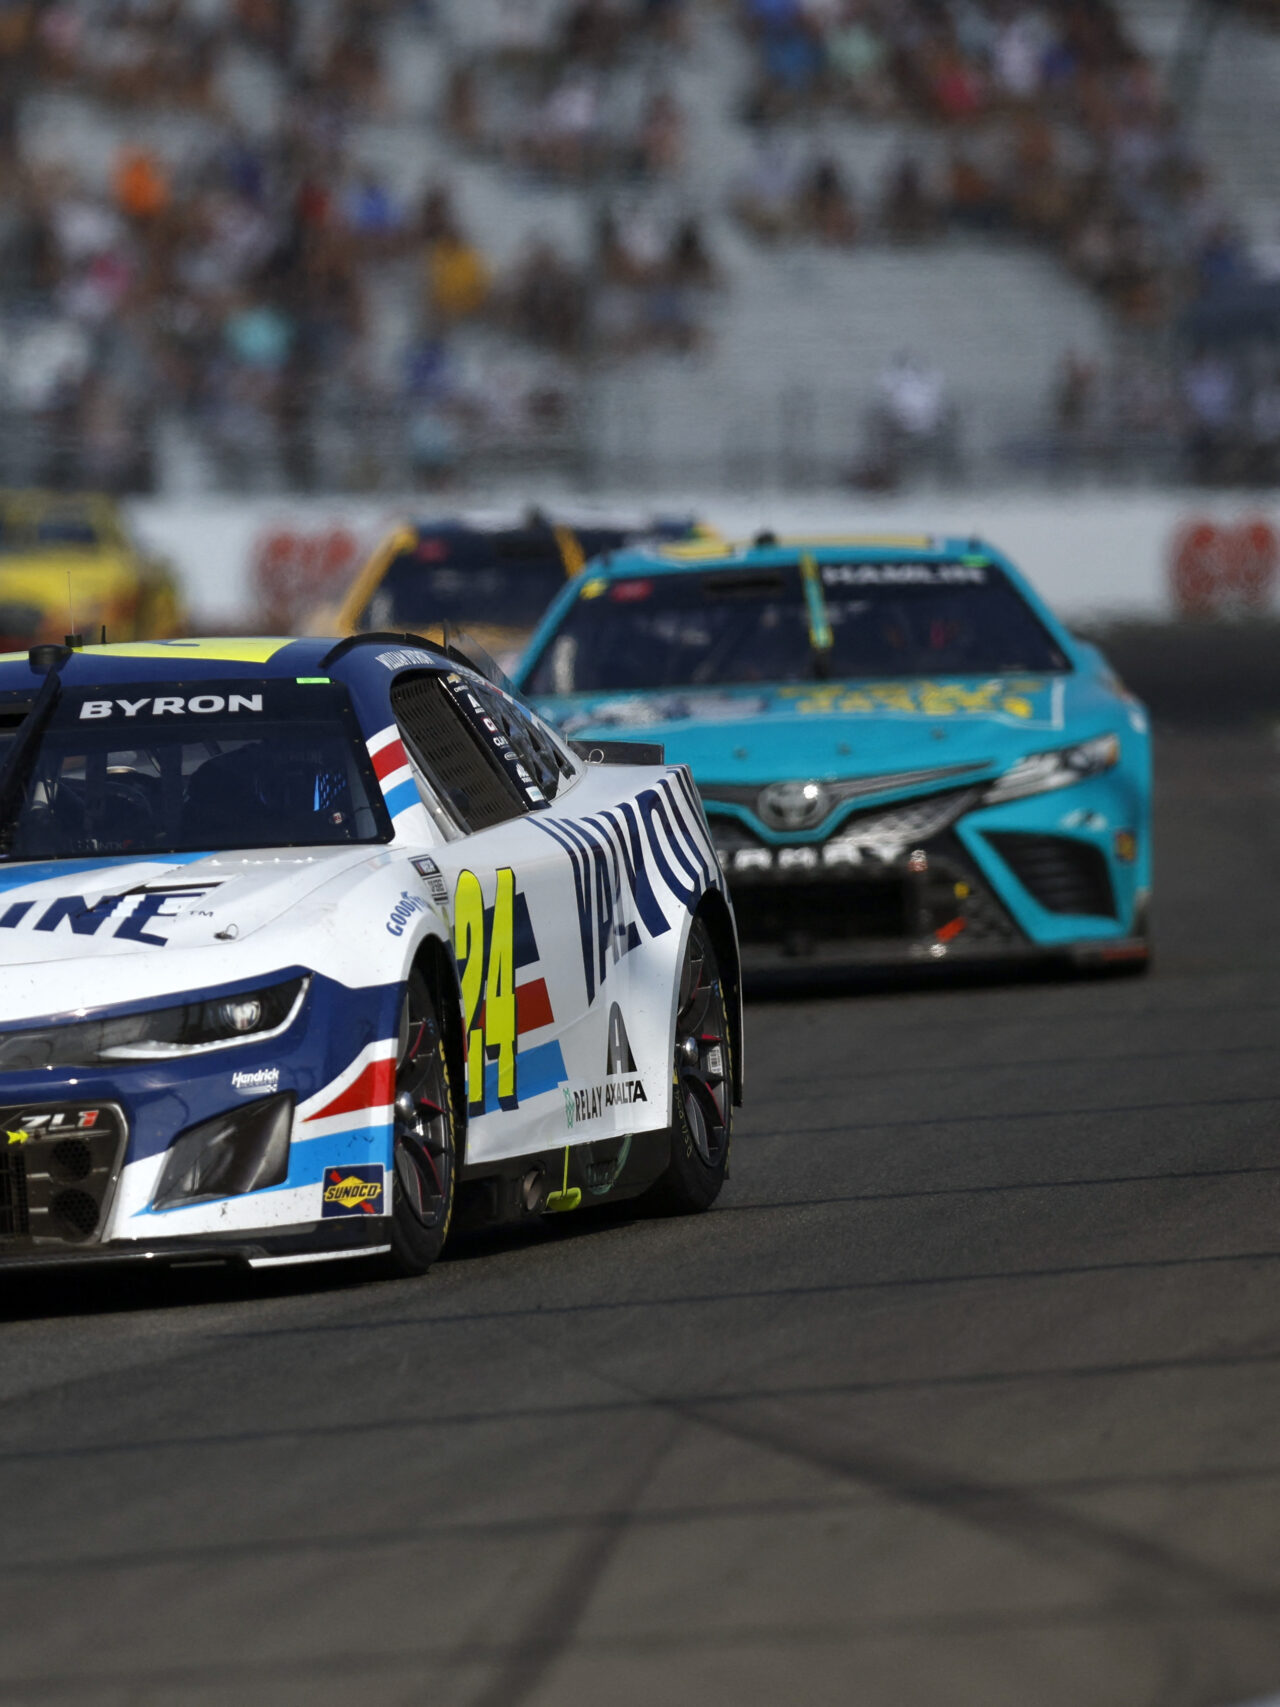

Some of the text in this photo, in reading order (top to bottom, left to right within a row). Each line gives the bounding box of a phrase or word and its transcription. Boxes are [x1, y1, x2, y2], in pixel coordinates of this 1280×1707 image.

[79, 694, 263, 720] BYRON
[454, 867, 518, 1112] 24
[231, 1067, 280, 1089] Hendrick
[573, 1079, 648, 1122] RELAY AXALTA
[325, 1184, 379, 1200] SUNOCO
